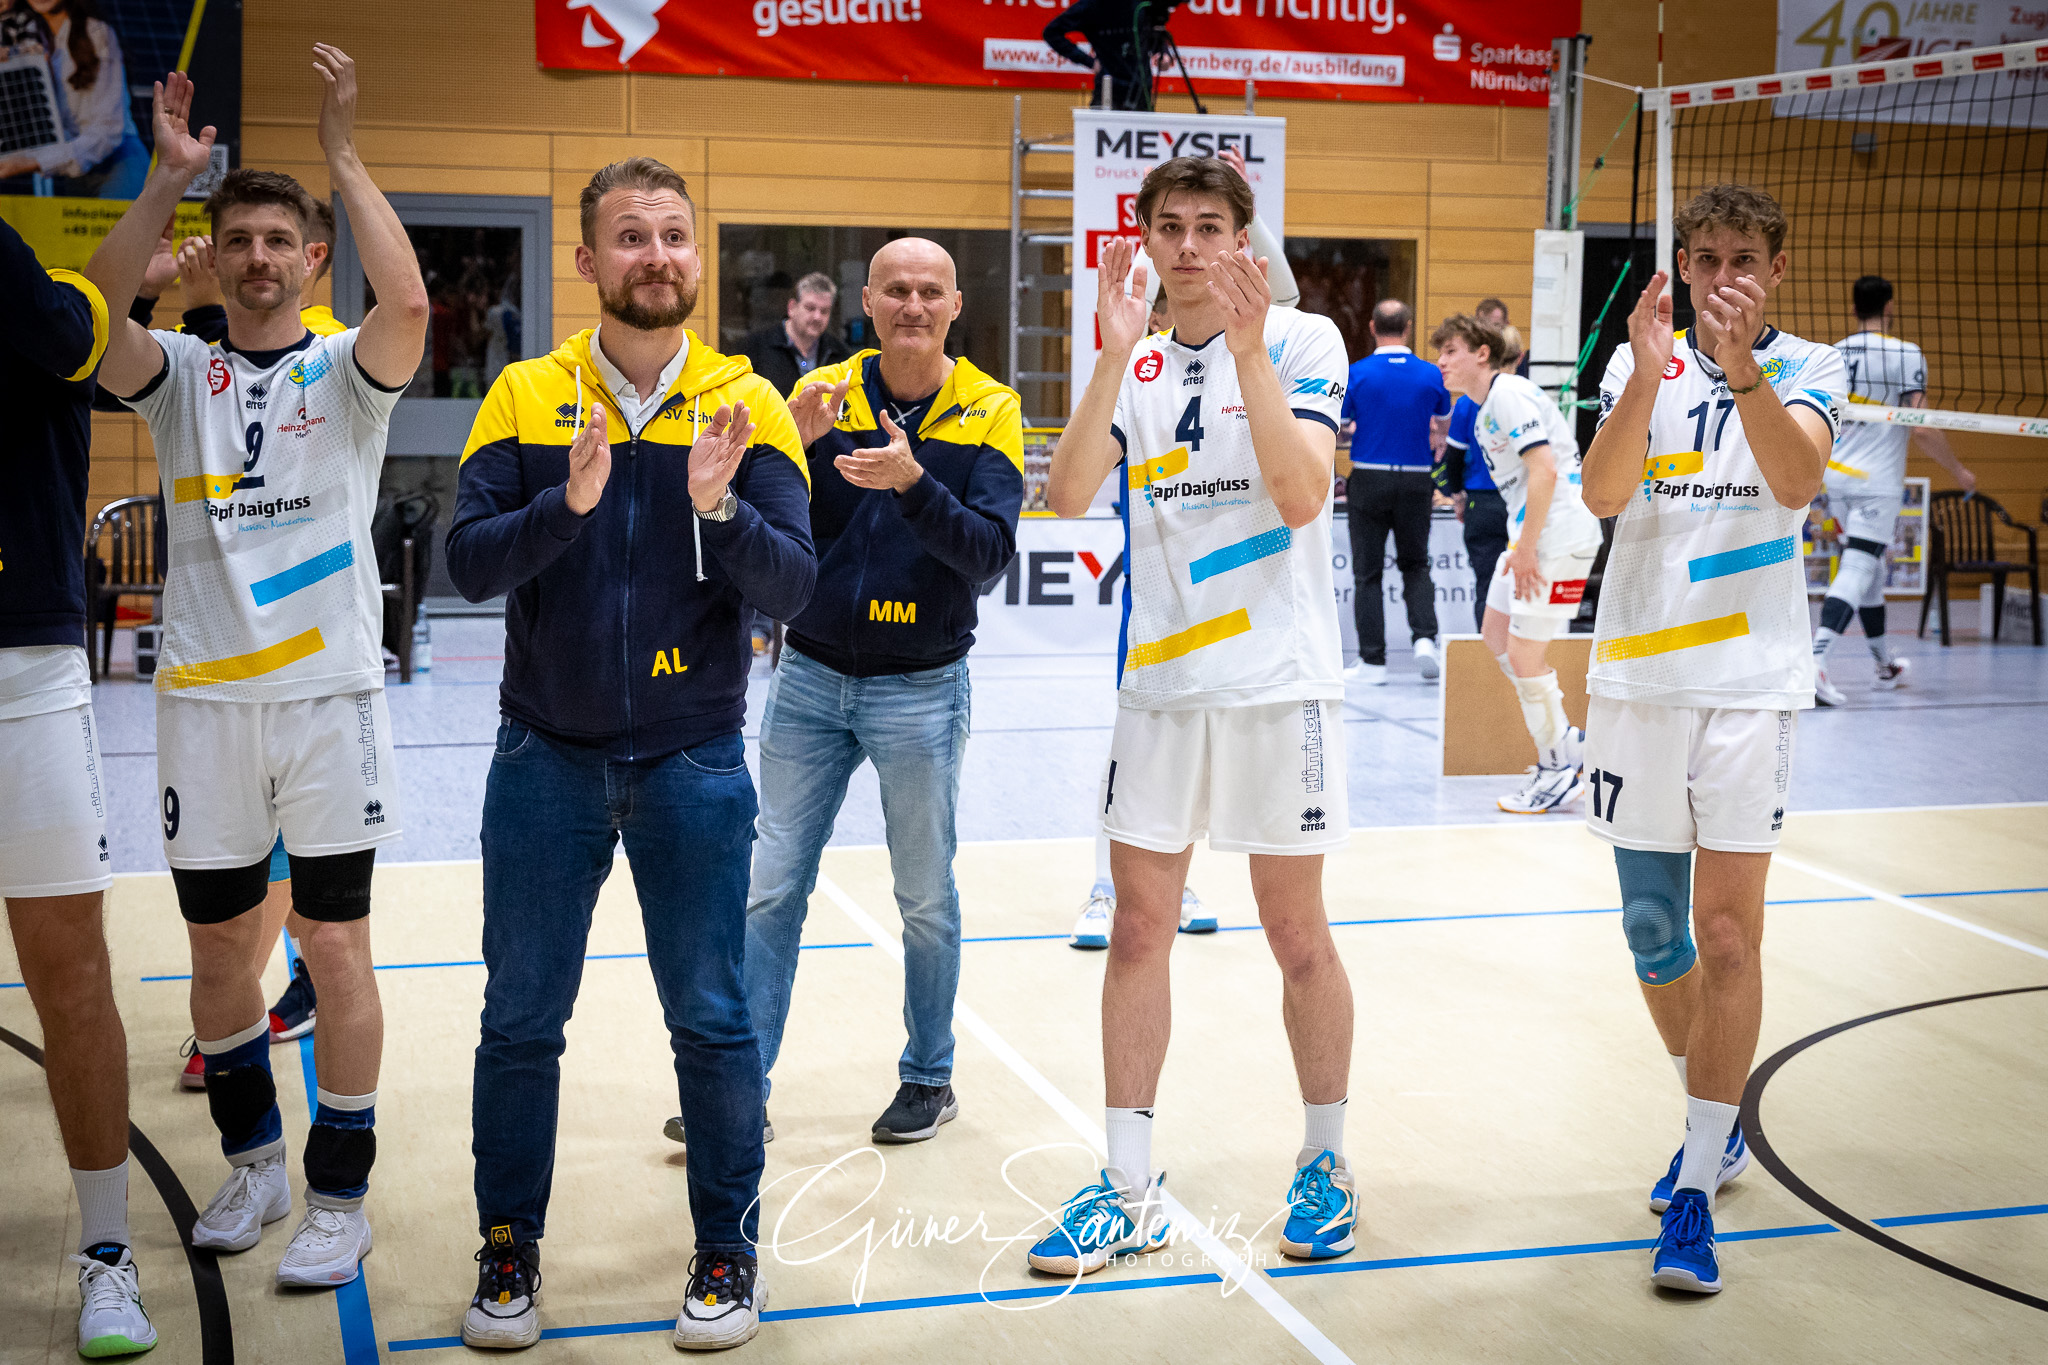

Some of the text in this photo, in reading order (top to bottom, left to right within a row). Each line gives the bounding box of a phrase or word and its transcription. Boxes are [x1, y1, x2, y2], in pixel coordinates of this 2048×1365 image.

[1470, 69, 1551, 92] Nürnber
[1096, 129, 1264, 163] MEYSEL
[1183, 375, 1204, 387] errea
[664, 408, 682, 421] SV
[1174, 394, 1204, 453] 4
[1687, 398, 1737, 453] 17
[1181, 477, 1250, 498] Daigfuss
[1653, 479, 1760, 500] Zapf Daigfuss
[238, 495, 311, 519] Daigfuss
[868, 599, 916, 624] MM
[651, 647, 688, 677] AL
[1590, 767, 1623, 823] 17
[164, 786, 180, 841] 9
[364, 814, 385, 826] errea
[1300, 822, 1326, 832] errea
